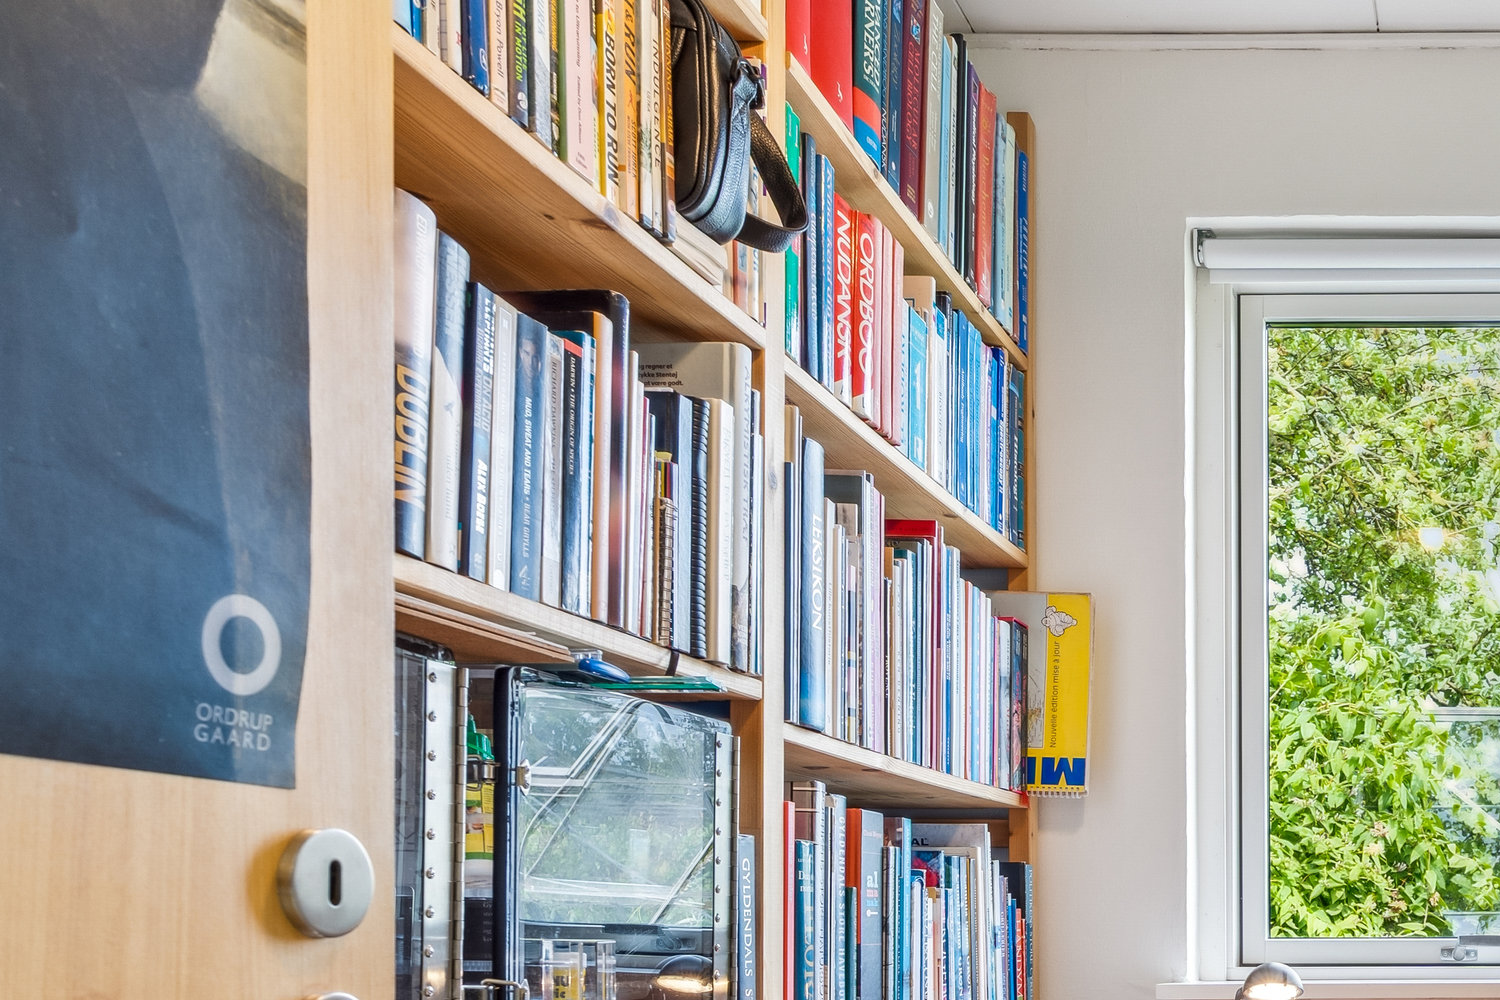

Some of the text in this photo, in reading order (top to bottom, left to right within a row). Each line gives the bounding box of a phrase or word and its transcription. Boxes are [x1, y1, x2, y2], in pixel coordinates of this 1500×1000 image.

[494, 2, 505, 78] Bryon Powell
[515, 21, 523, 34] IN
[931, 14, 939, 50] THE
[514, 37, 523, 82] MOTION
[624, 23, 637, 85] RUN
[931, 51, 939, 92] CELL
[604, 31, 620, 187] BORN TO RUN
[652, 39, 661, 169] INDULGENCE
[905, 41, 915, 142] CELL BIOLOGY
[910, 48, 921, 151] MOLECULAR
[970, 151, 978, 206] Physiology
[836, 209, 852, 360] NUDANSK
[569, 356, 577, 388] DARWIN
[656, 371, 678, 379] Stentøj
[667, 379, 684, 388] godt.
[524, 396, 533, 420] MUD,
[568, 406, 576, 434] ORIGIN
[394, 362, 430, 513] DUBLIN
[524, 420, 532, 447] SWEAT
[568, 435, 575, 447] OF
[476, 459, 488, 493] ALEX
[524, 448, 532, 468] AND
[1012, 434, 1020, 501] Histologi
[523, 468, 532, 495] TEARS
[811, 513, 823, 631] LEKSIKON
[1049, 640, 1062, 748] Nouvelle édition mise à jour
[193, 723, 272, 752] GAARD
[195, 702, 274, 733] ORDRUP
[838, 815, 846, 897] GYLDENDALS
[866, 871, 878, 888] al
[742, 857, 752, 977] GYLDENDALS
[838, 902, 846, 942] STORE
